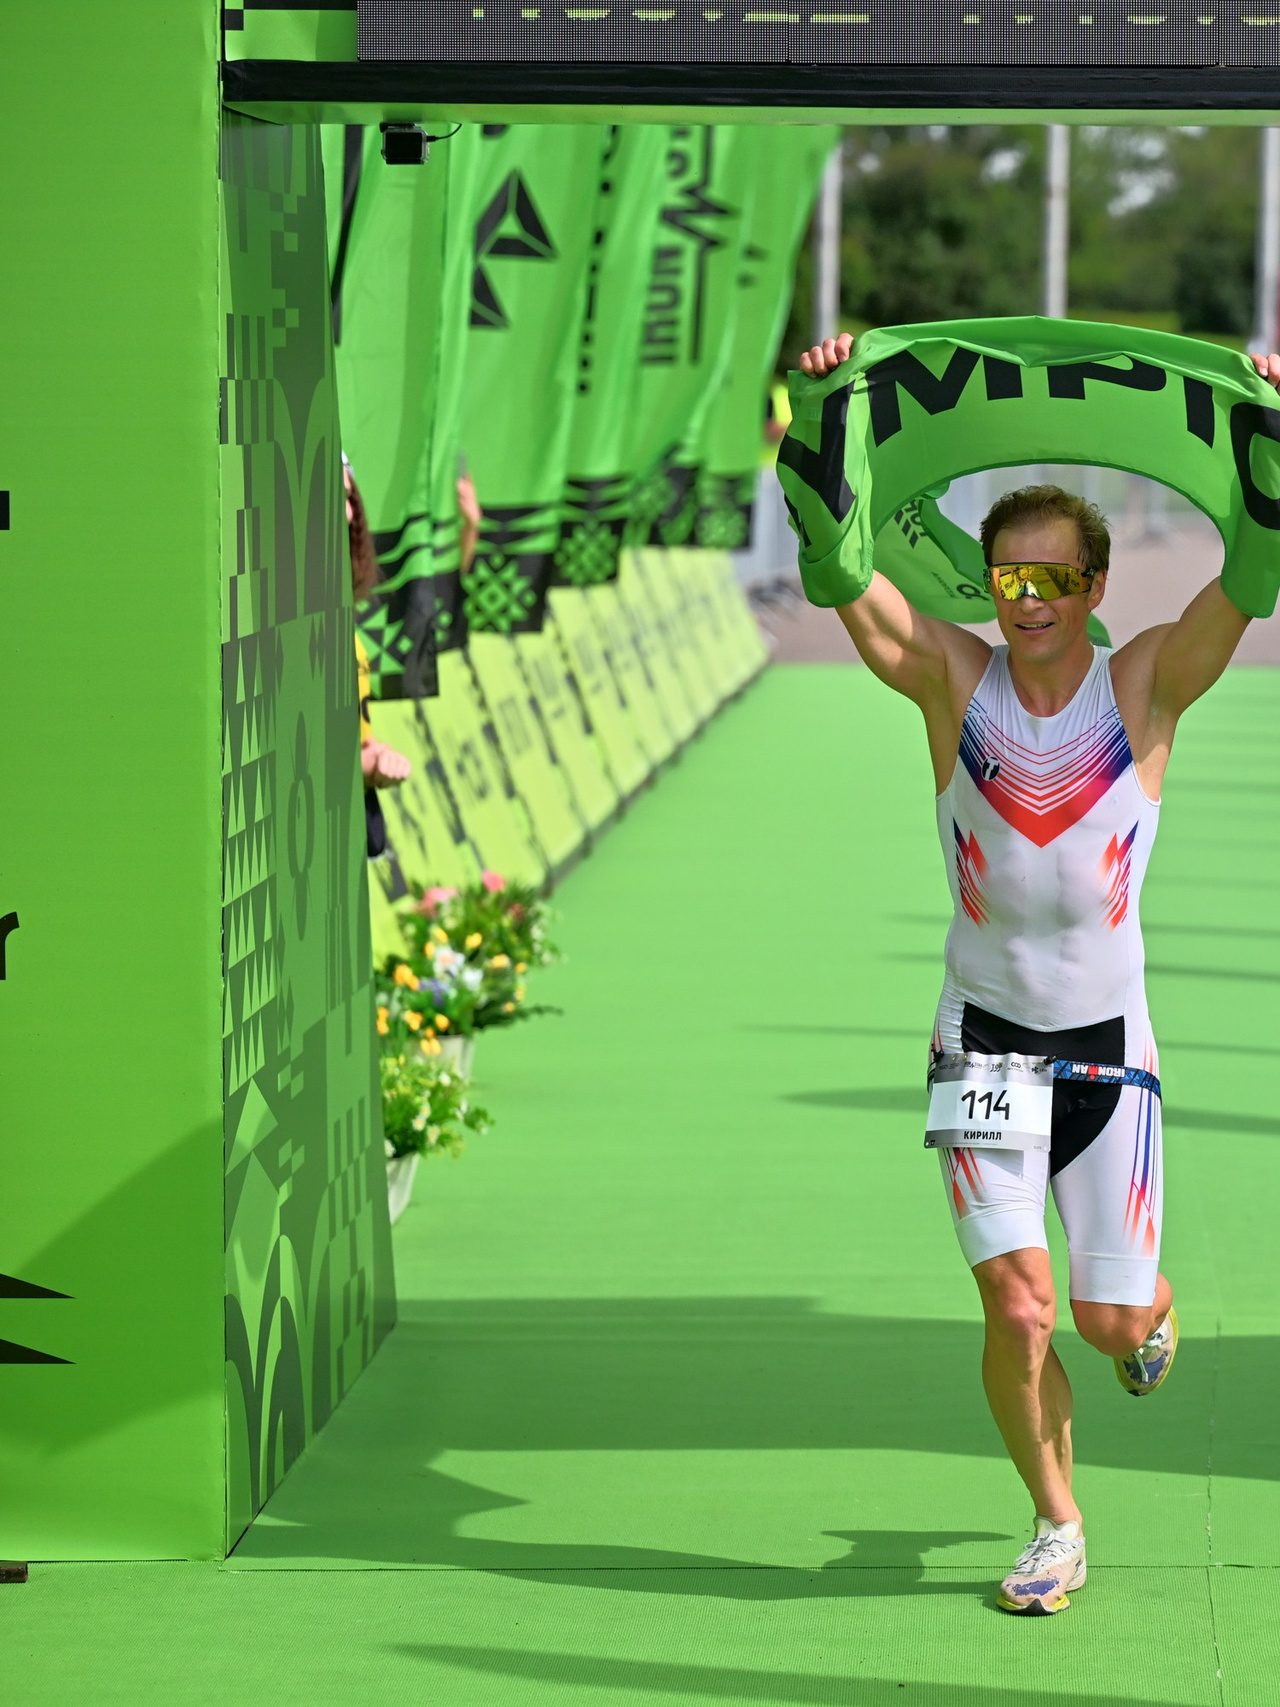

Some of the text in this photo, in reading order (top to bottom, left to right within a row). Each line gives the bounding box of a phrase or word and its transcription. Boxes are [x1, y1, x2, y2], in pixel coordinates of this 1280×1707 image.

[1072, 1063, 1126, 1080] IRONMAN
[961, 1089, 1010, 1120] 114
[963, 1130, 1002, 1141] КИРИЛЛ
